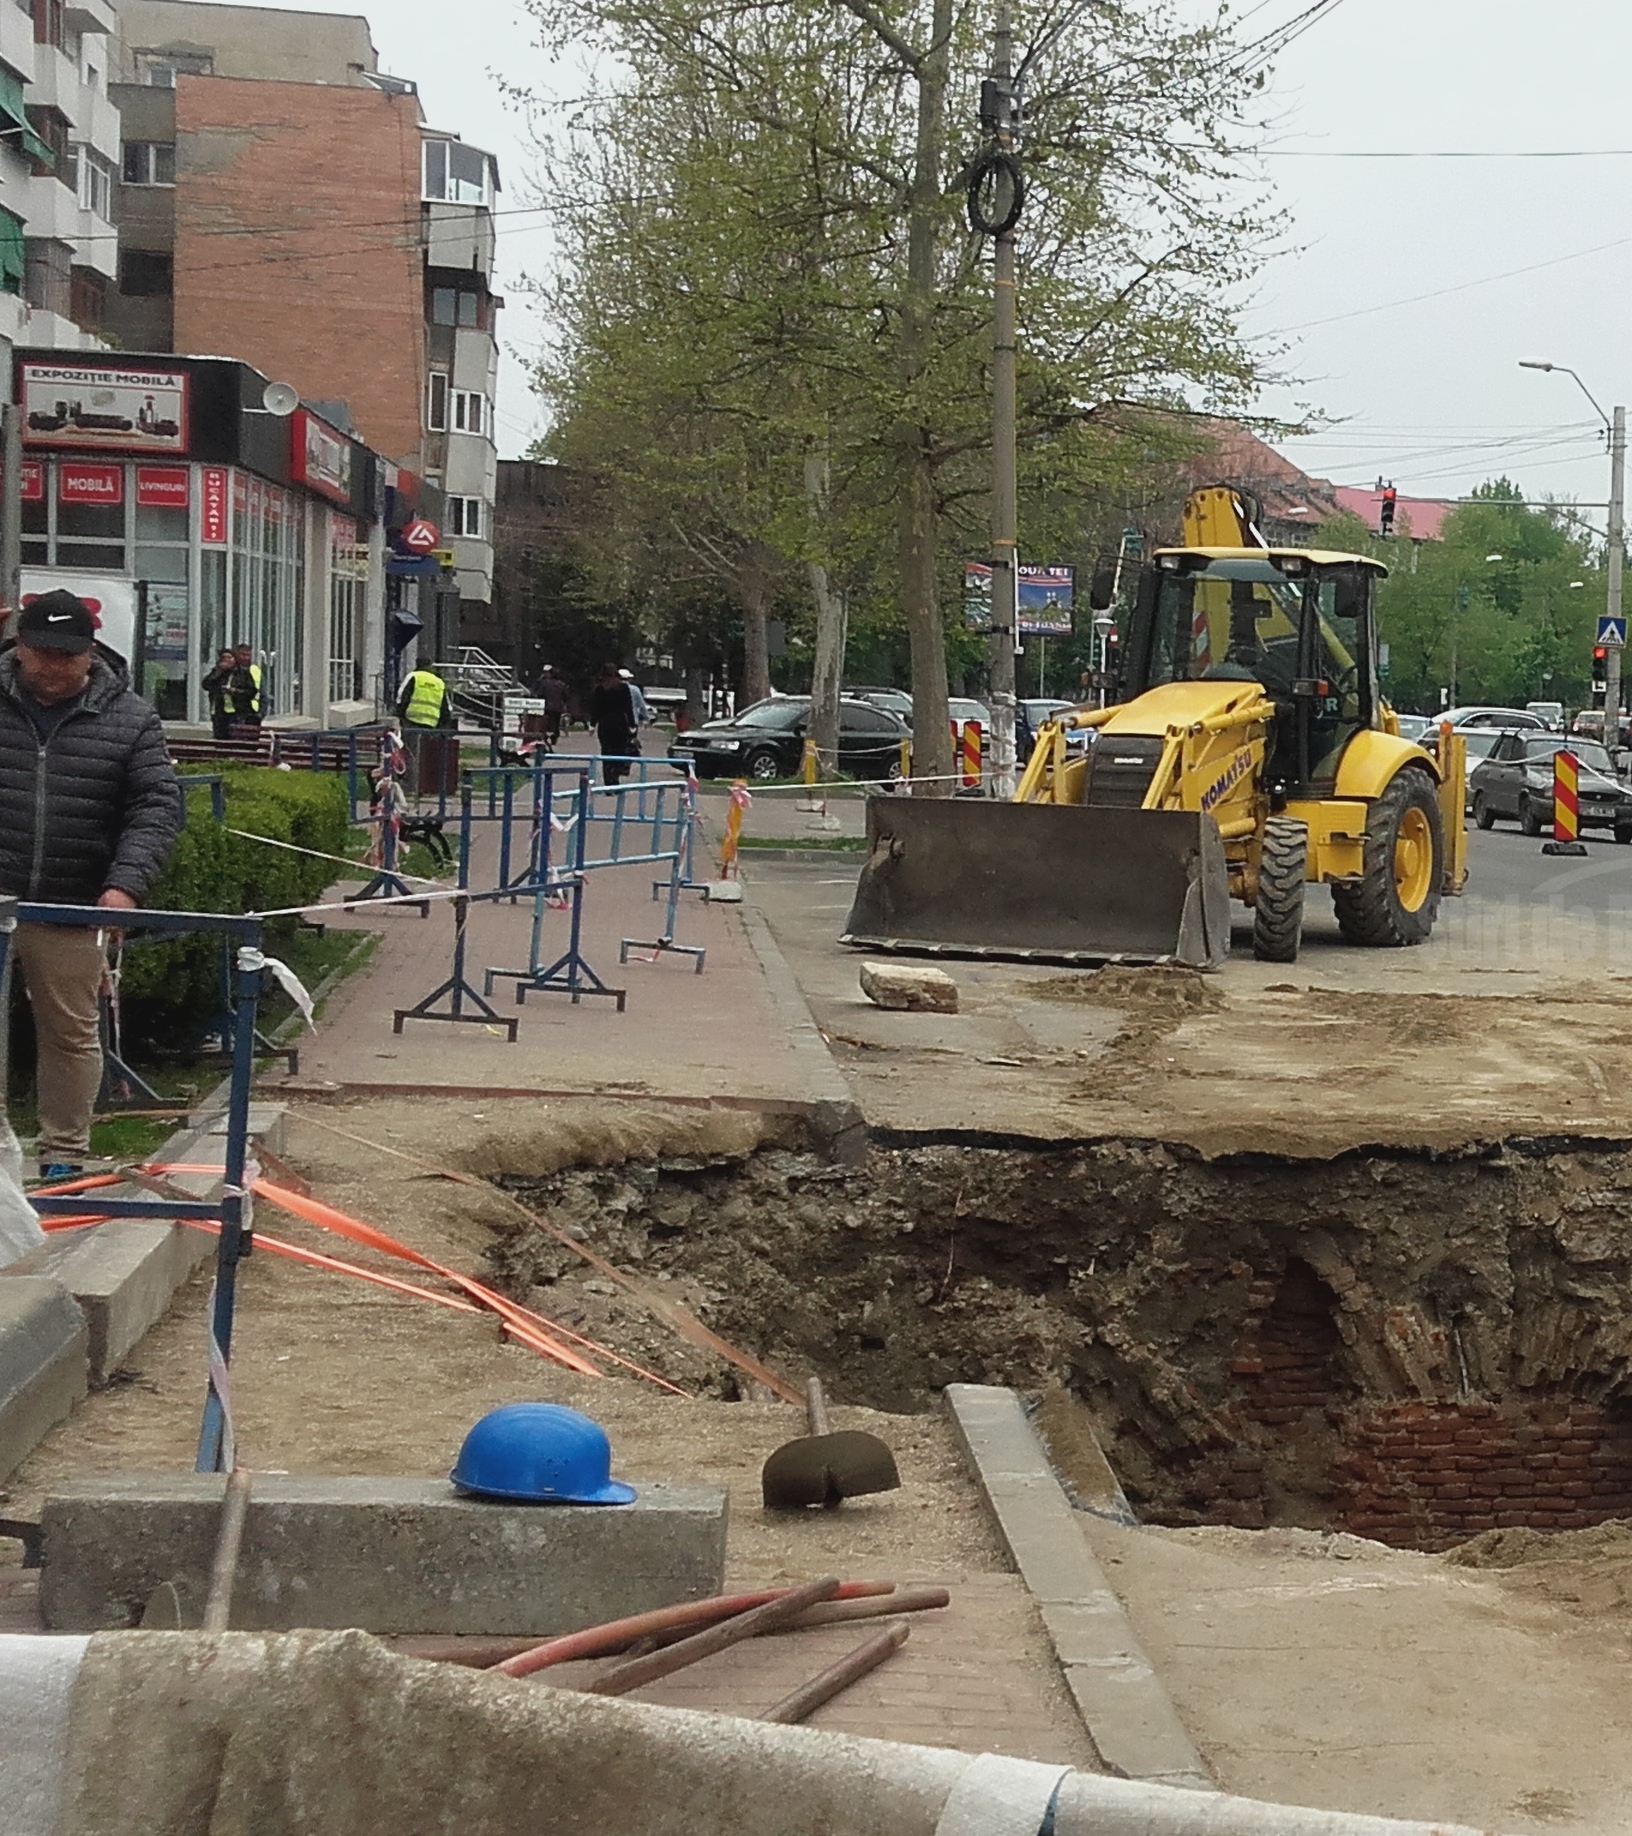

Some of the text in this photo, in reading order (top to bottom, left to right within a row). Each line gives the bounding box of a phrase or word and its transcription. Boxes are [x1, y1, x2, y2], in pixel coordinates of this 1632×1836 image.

[67, 475, 114, 493] MOBILĂ
[140, 481, 186, 493] LIVINGURI
[1201, 748, 1253, 811] KOMATSU
